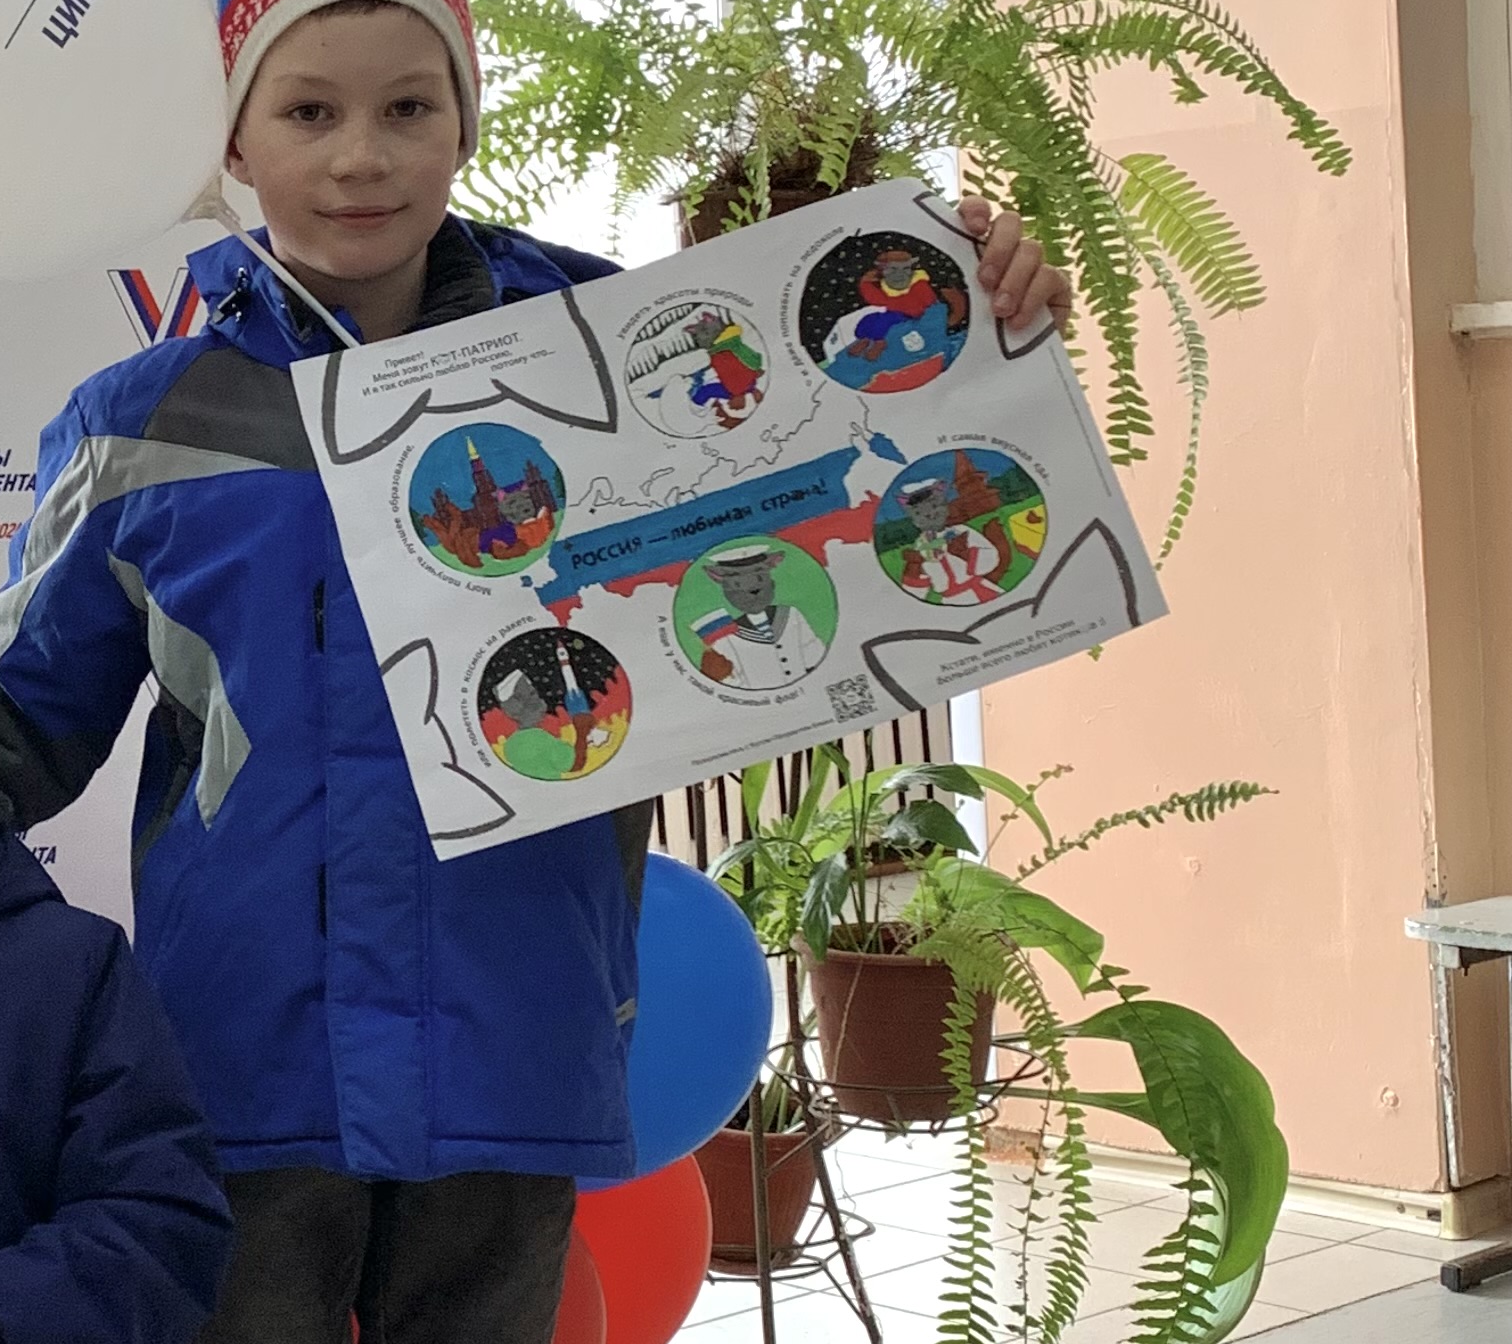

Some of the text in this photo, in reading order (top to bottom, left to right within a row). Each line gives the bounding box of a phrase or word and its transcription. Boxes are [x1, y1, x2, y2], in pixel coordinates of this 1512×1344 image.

[571, 478, 829, 569] РОССИЯ любимая страна!
